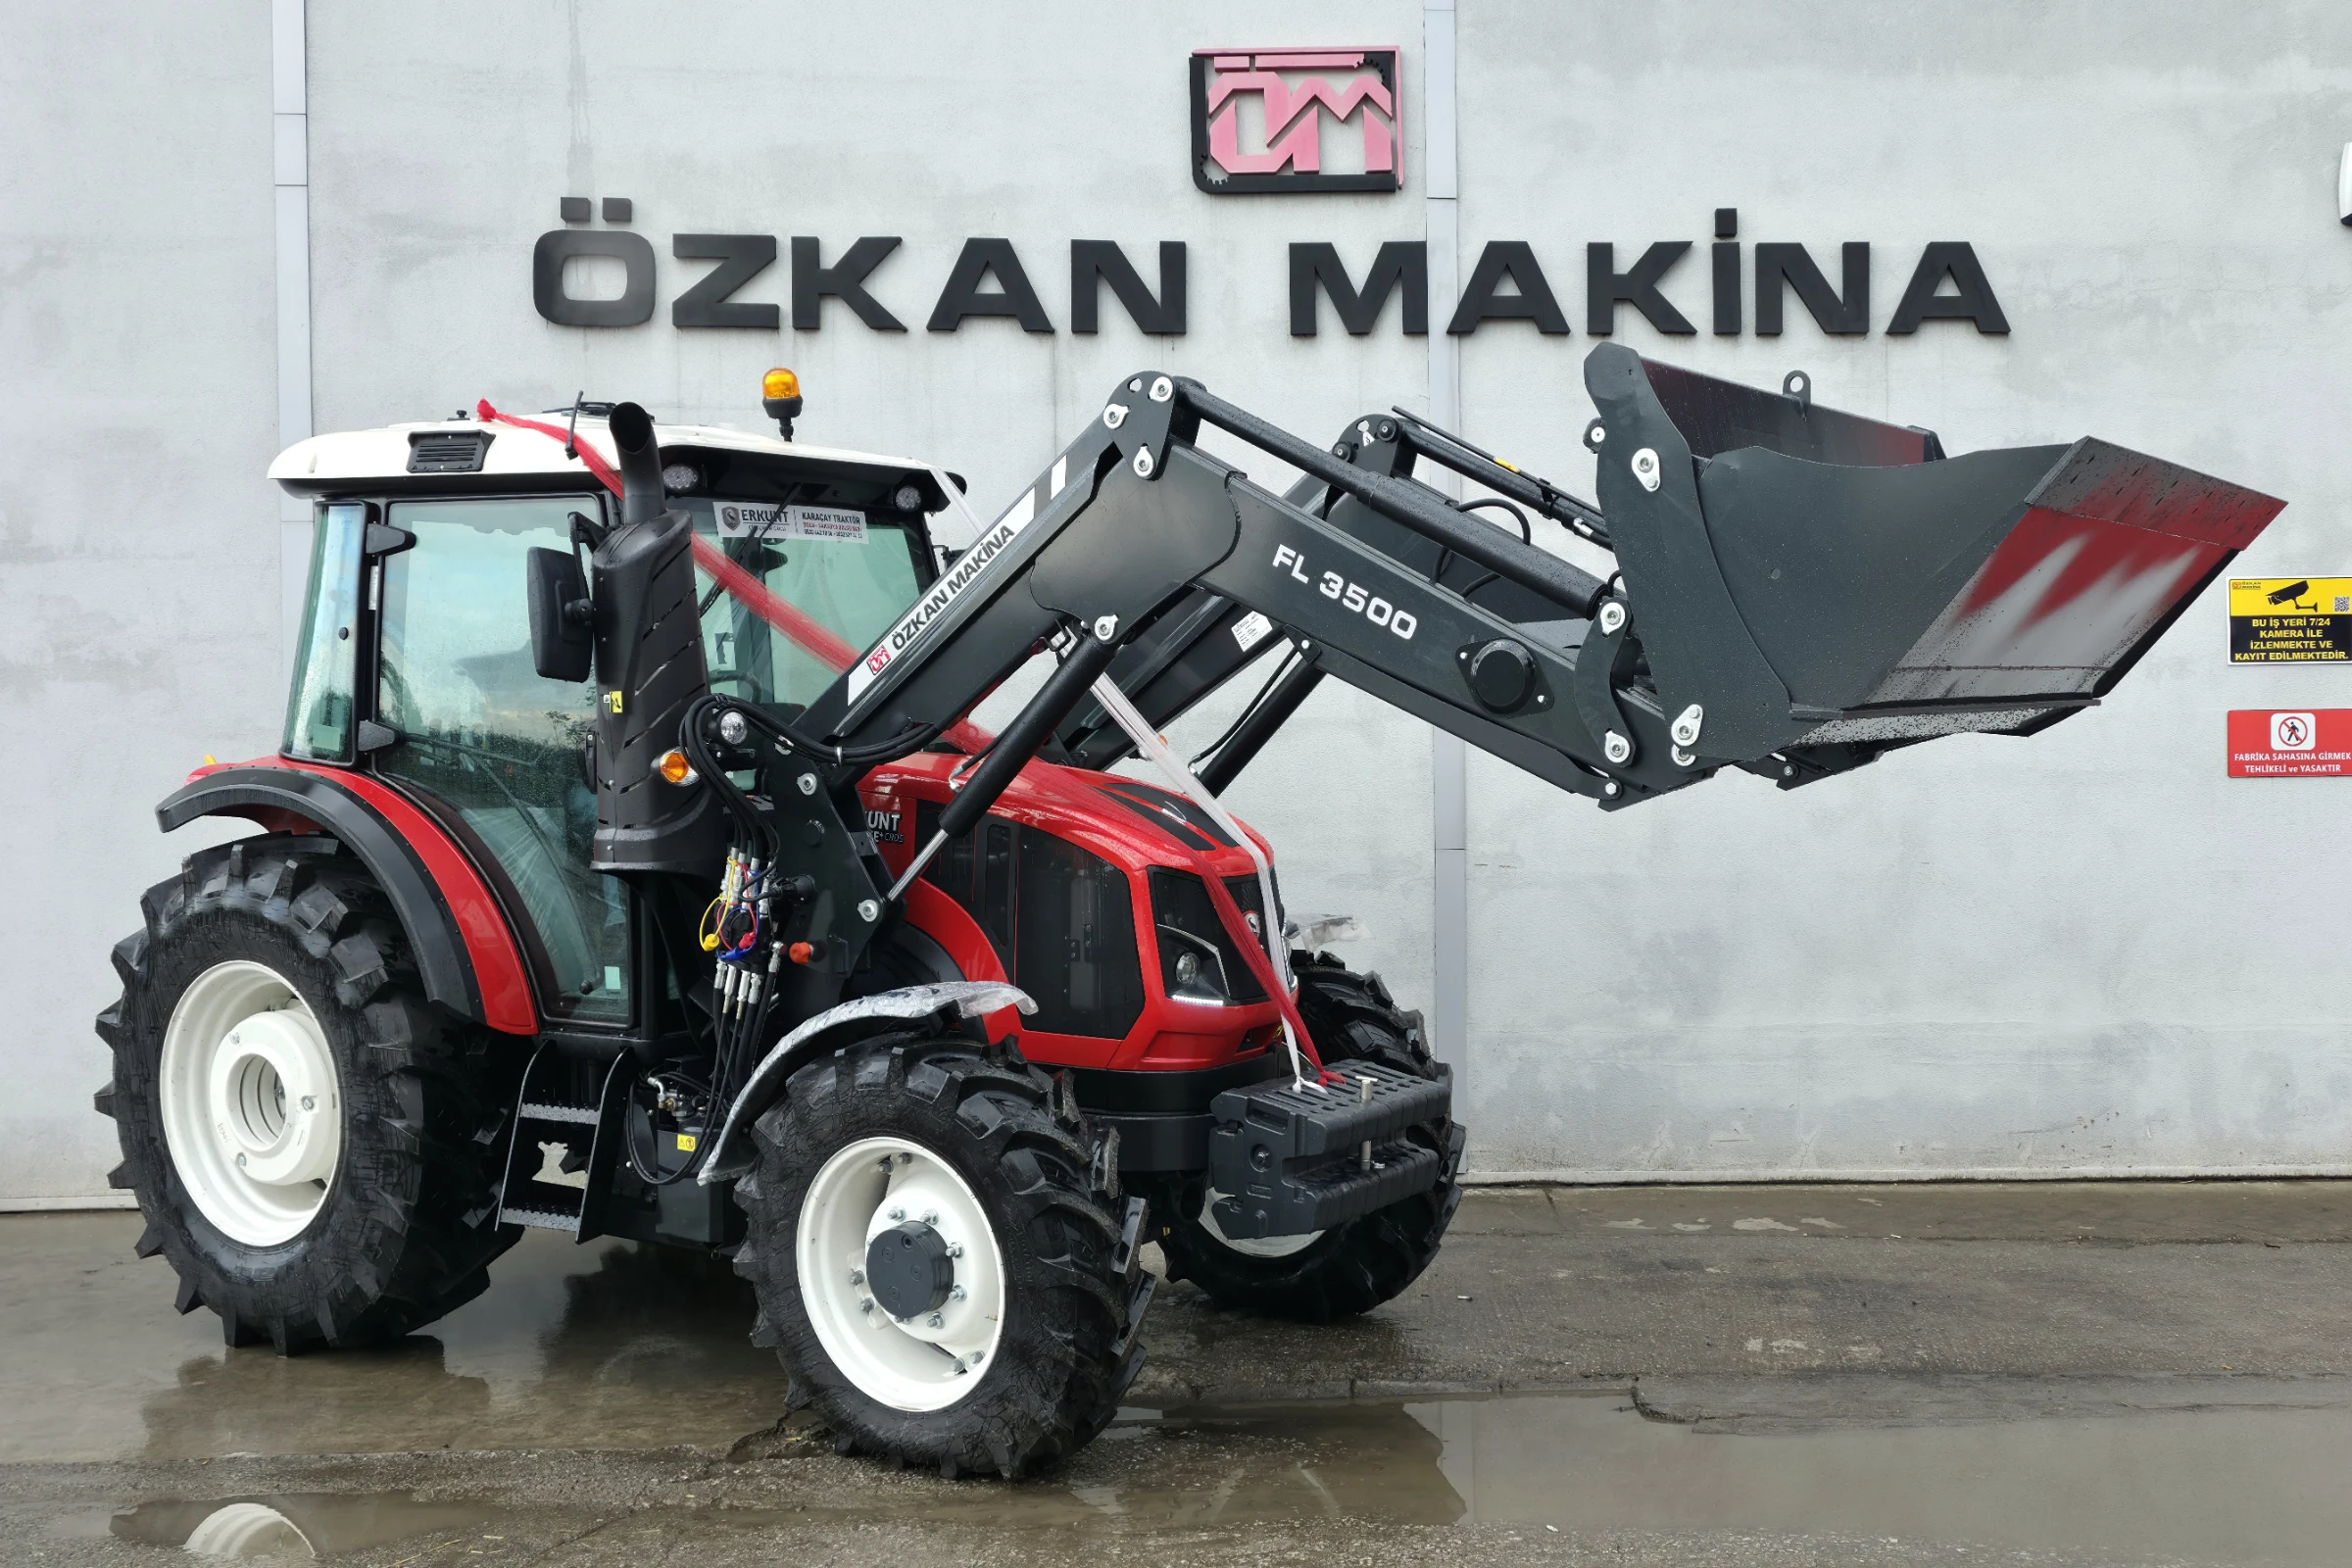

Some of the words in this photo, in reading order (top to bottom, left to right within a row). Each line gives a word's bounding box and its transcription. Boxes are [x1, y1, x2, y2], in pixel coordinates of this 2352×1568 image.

[533, 196, 1187, 335] ÖZKAN
[1289, 208, 2012, 336] MAKİNA
[741, 509, 788, 522] ERKUNT
[892, 588, 950, 651] ÖZKAN
[947, 524, 1015, 595] MAKİNA
[1272, 544, 1309, 584] FL
[1319, 570, 1417, 640] 3500
[2252, 618, 2267, 627] BU
[2270, 617, 2280, 628] İŞ
[2282, 616, 2307, 627] YERİ
[2309, 617, 2330, 626] 7/24
[2307, 628, 2323, 637] İLE
[2250, 640, 2316, 650] İZLENMEKTE
[2319, 640, 2332, 649] VE
[2234, 752, 2271, 761] FABRİKA
[2318, 751, 2352, 760] GİRMEK
[2245, 763, 2286, 773] TEHLİKELİ
[865, 809, 901, 831] UNT
